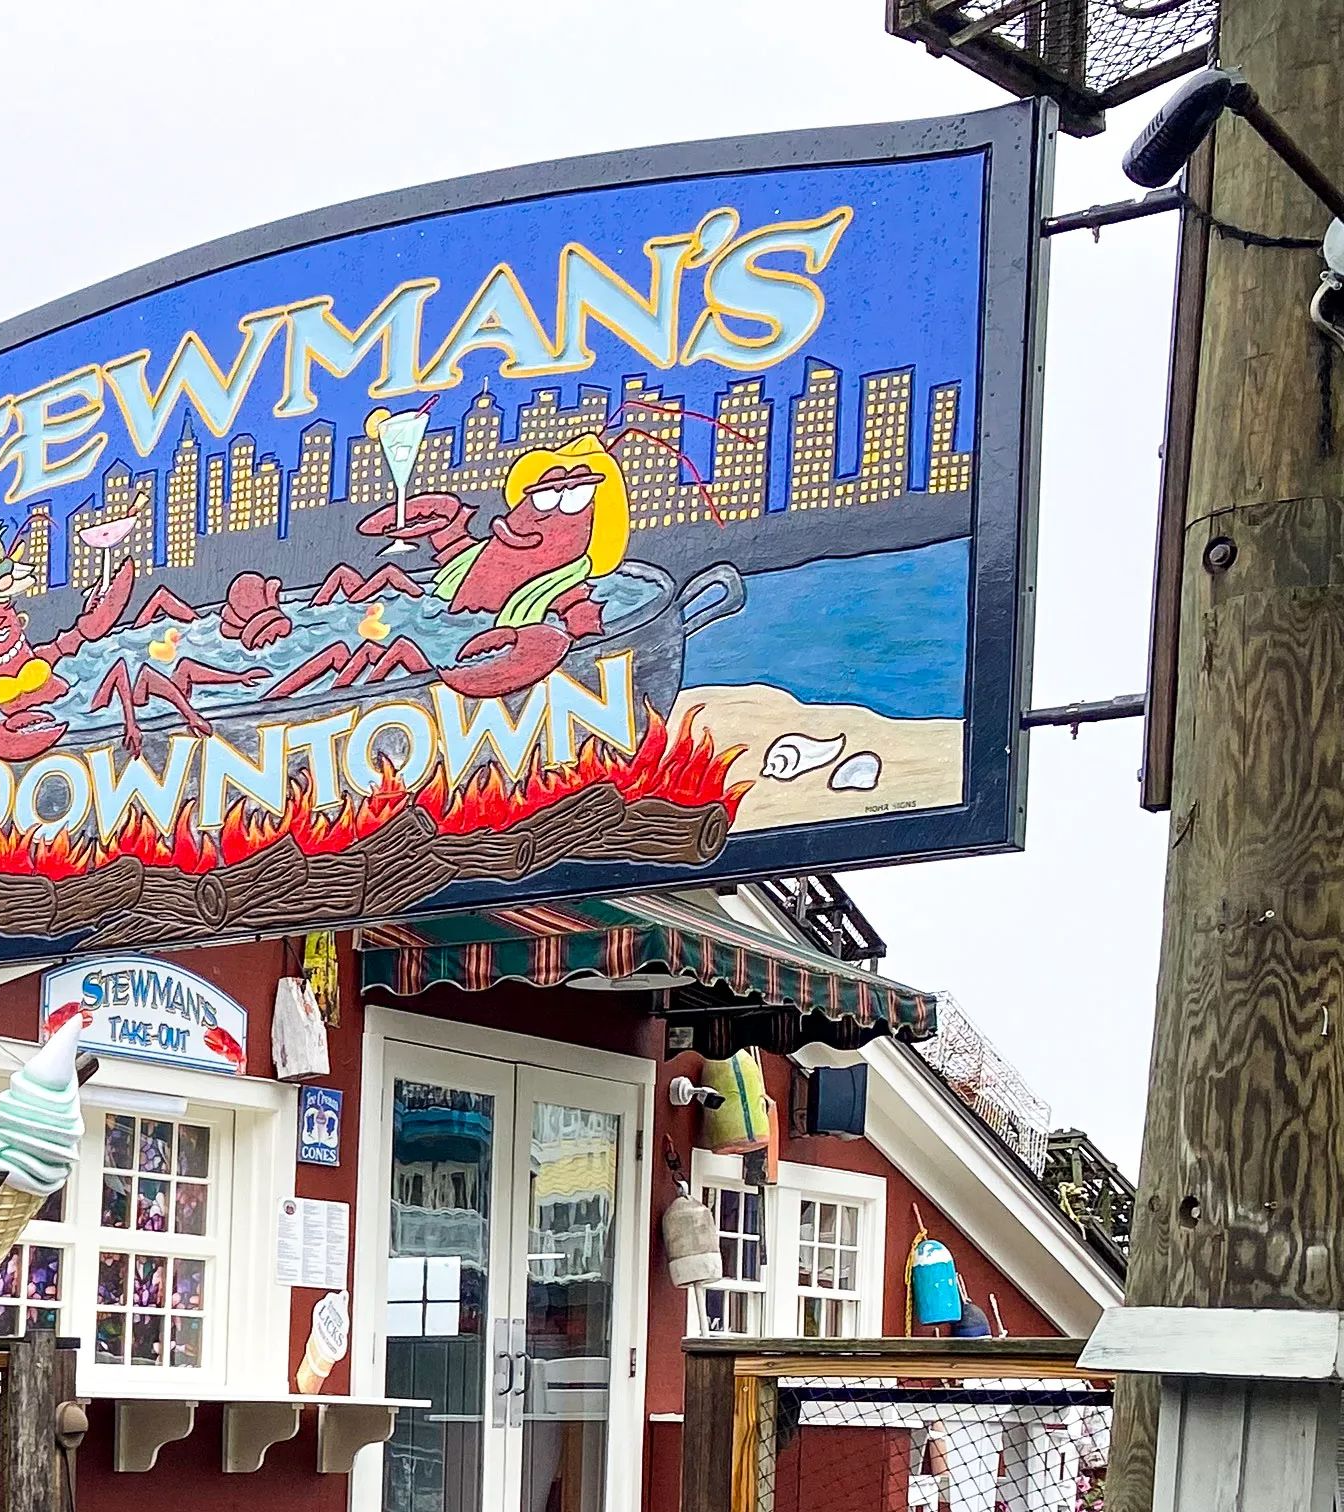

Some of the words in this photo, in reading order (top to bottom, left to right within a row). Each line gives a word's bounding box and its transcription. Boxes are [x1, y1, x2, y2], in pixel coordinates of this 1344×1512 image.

[79, 969, 219, 1029] STEWMAN'S
[108, 1015, 190, 1053] TAKE-OUT
[302, 1146, 337, 1161] CONES
[318, 1304, 344, 1347] LICKS
